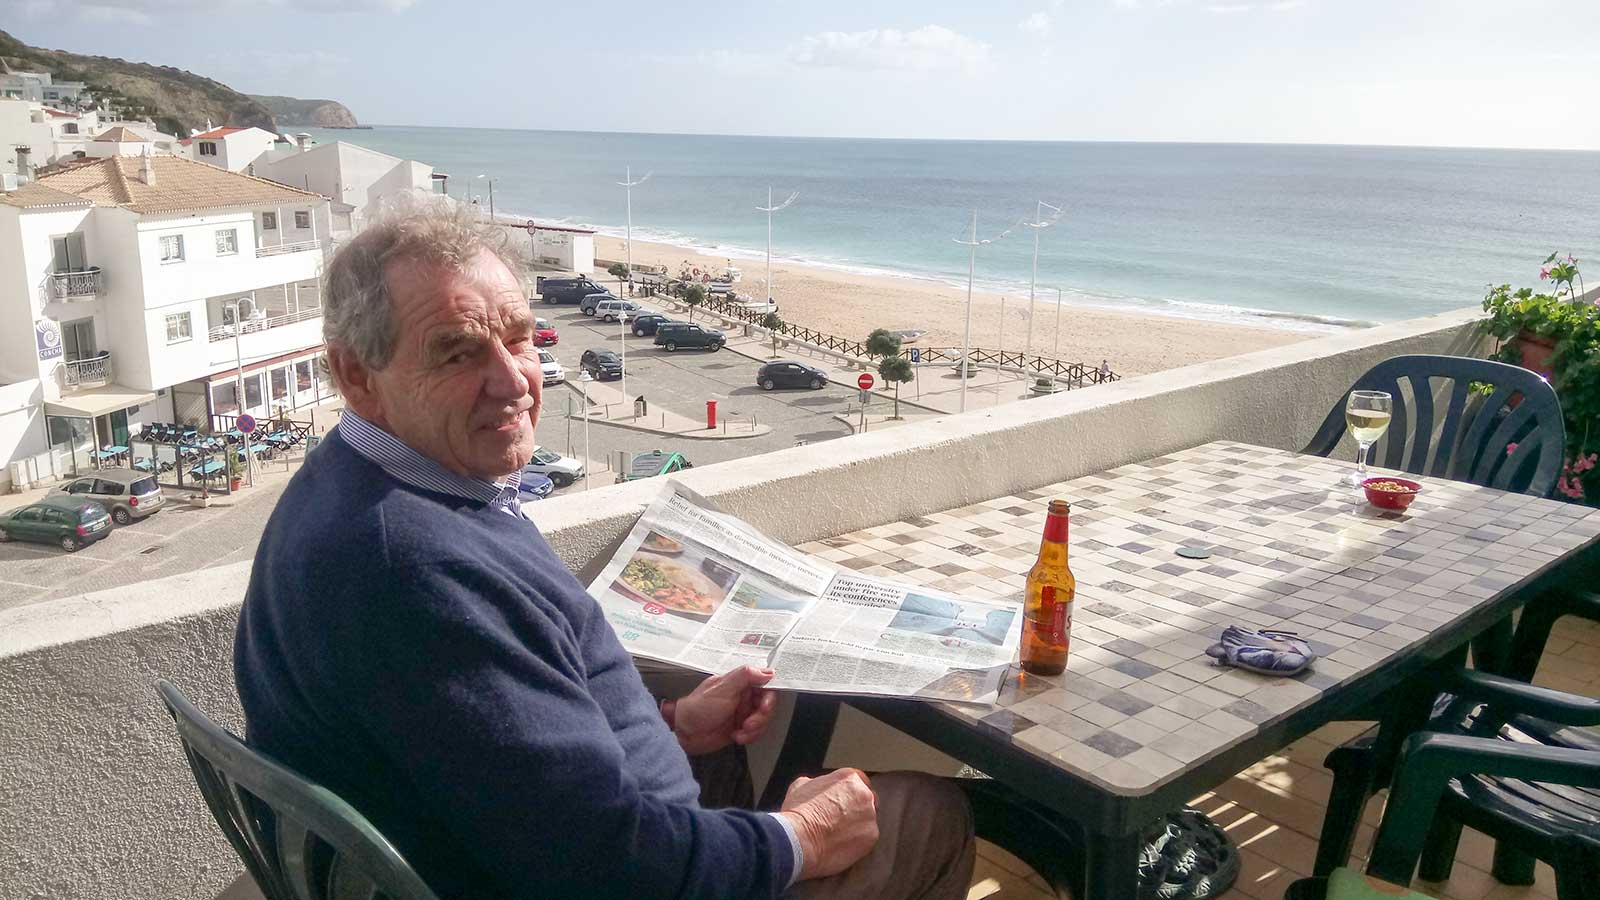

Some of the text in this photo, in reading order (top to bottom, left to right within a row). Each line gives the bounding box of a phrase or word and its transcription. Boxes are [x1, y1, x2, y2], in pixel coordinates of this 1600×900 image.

[912, 350, 919, 361] P
[668, 497, 688, 513] Relief
[688, 509, 698, 518] for
[698, 514, 726, 533] families
[833, 585, 901, 600] under fire over
[837, 579, 901, 595] Top university
[843, 593, 898, 606] conferences
